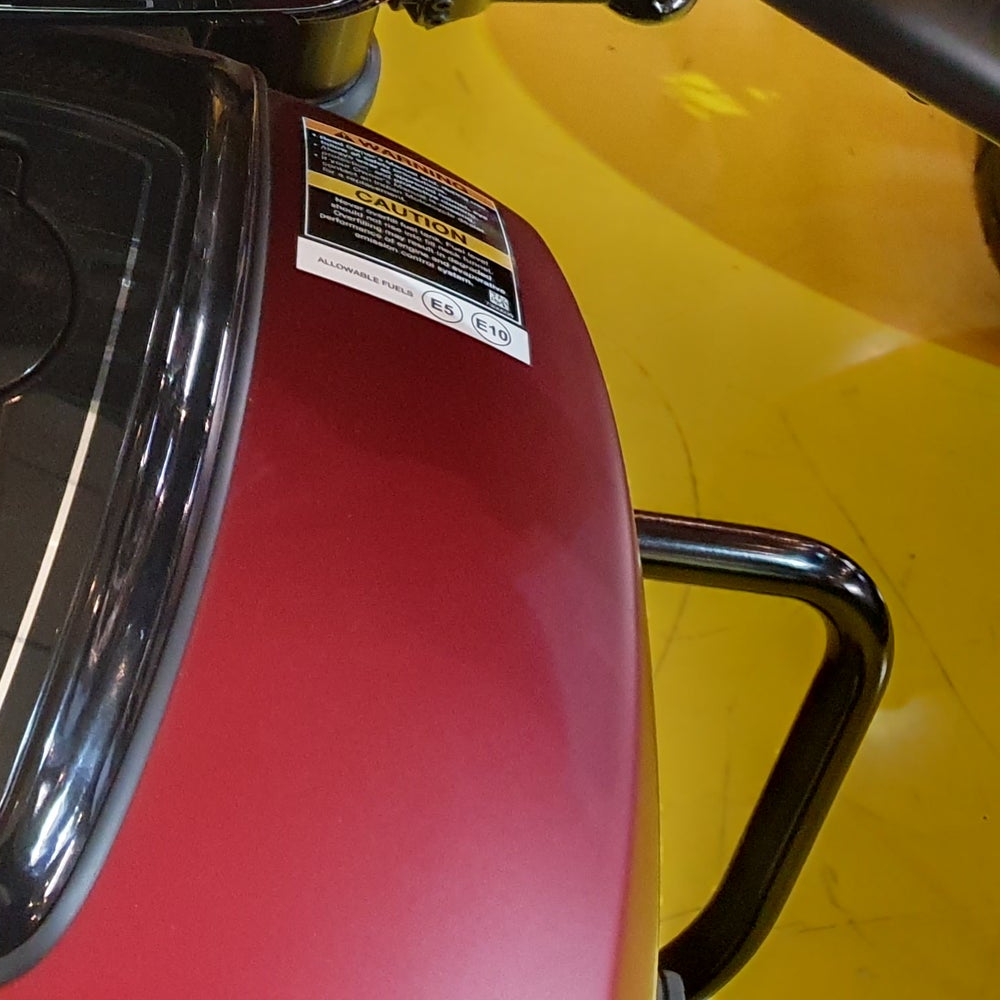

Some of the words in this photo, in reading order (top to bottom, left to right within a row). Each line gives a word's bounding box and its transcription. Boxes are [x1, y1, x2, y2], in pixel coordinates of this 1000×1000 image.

[358, 137, 469, 194] WARNING
[355, 190, 467, 244] CAUTION
[317, 256, 379, 284] ALLOWABLE
[381, 281, 414, 298] FUELS
[430, 293, 454, 316] E5
[475, 318, 508, 342] E10
